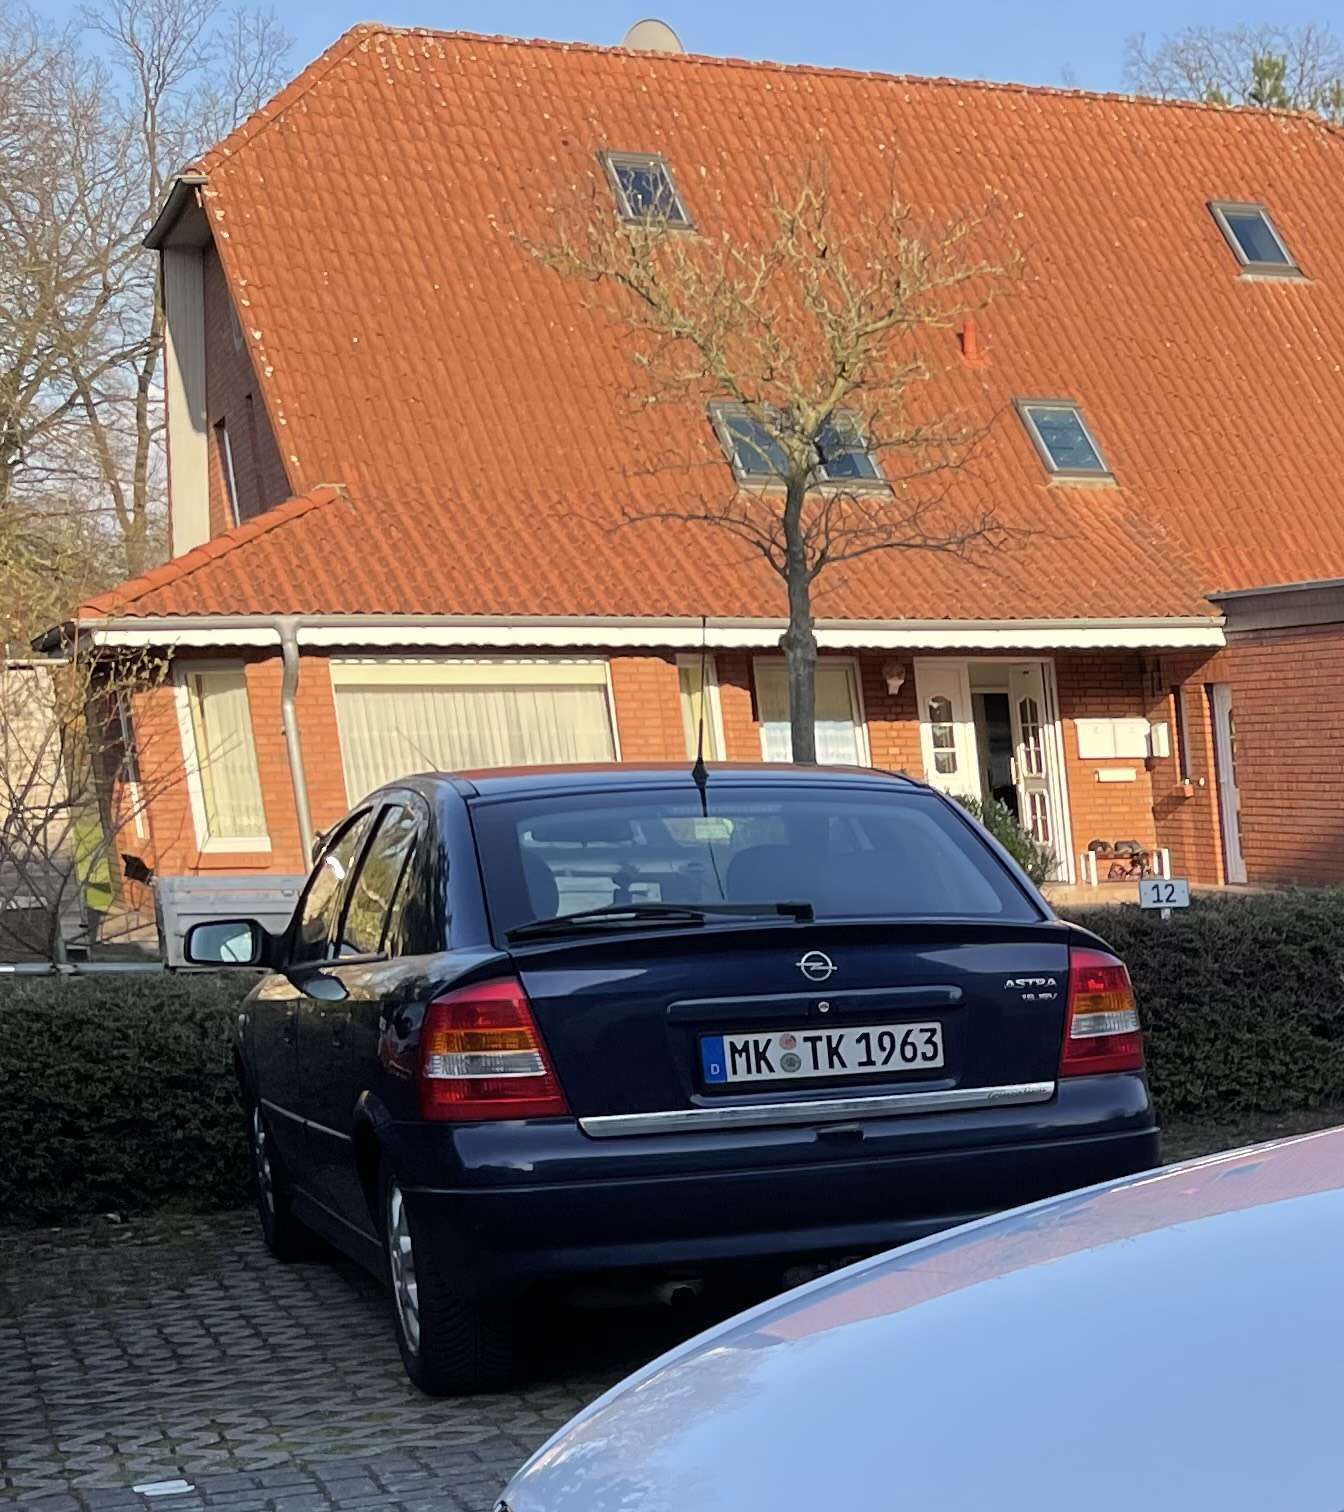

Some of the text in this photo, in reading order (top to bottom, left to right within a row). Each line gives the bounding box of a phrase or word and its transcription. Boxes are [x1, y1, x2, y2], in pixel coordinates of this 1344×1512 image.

[1151, 883, 1177, 904] 12
[1003, 977, 1057, 990] ASTRA
[710, 1027, 939, 1076] D MK TK 1963
